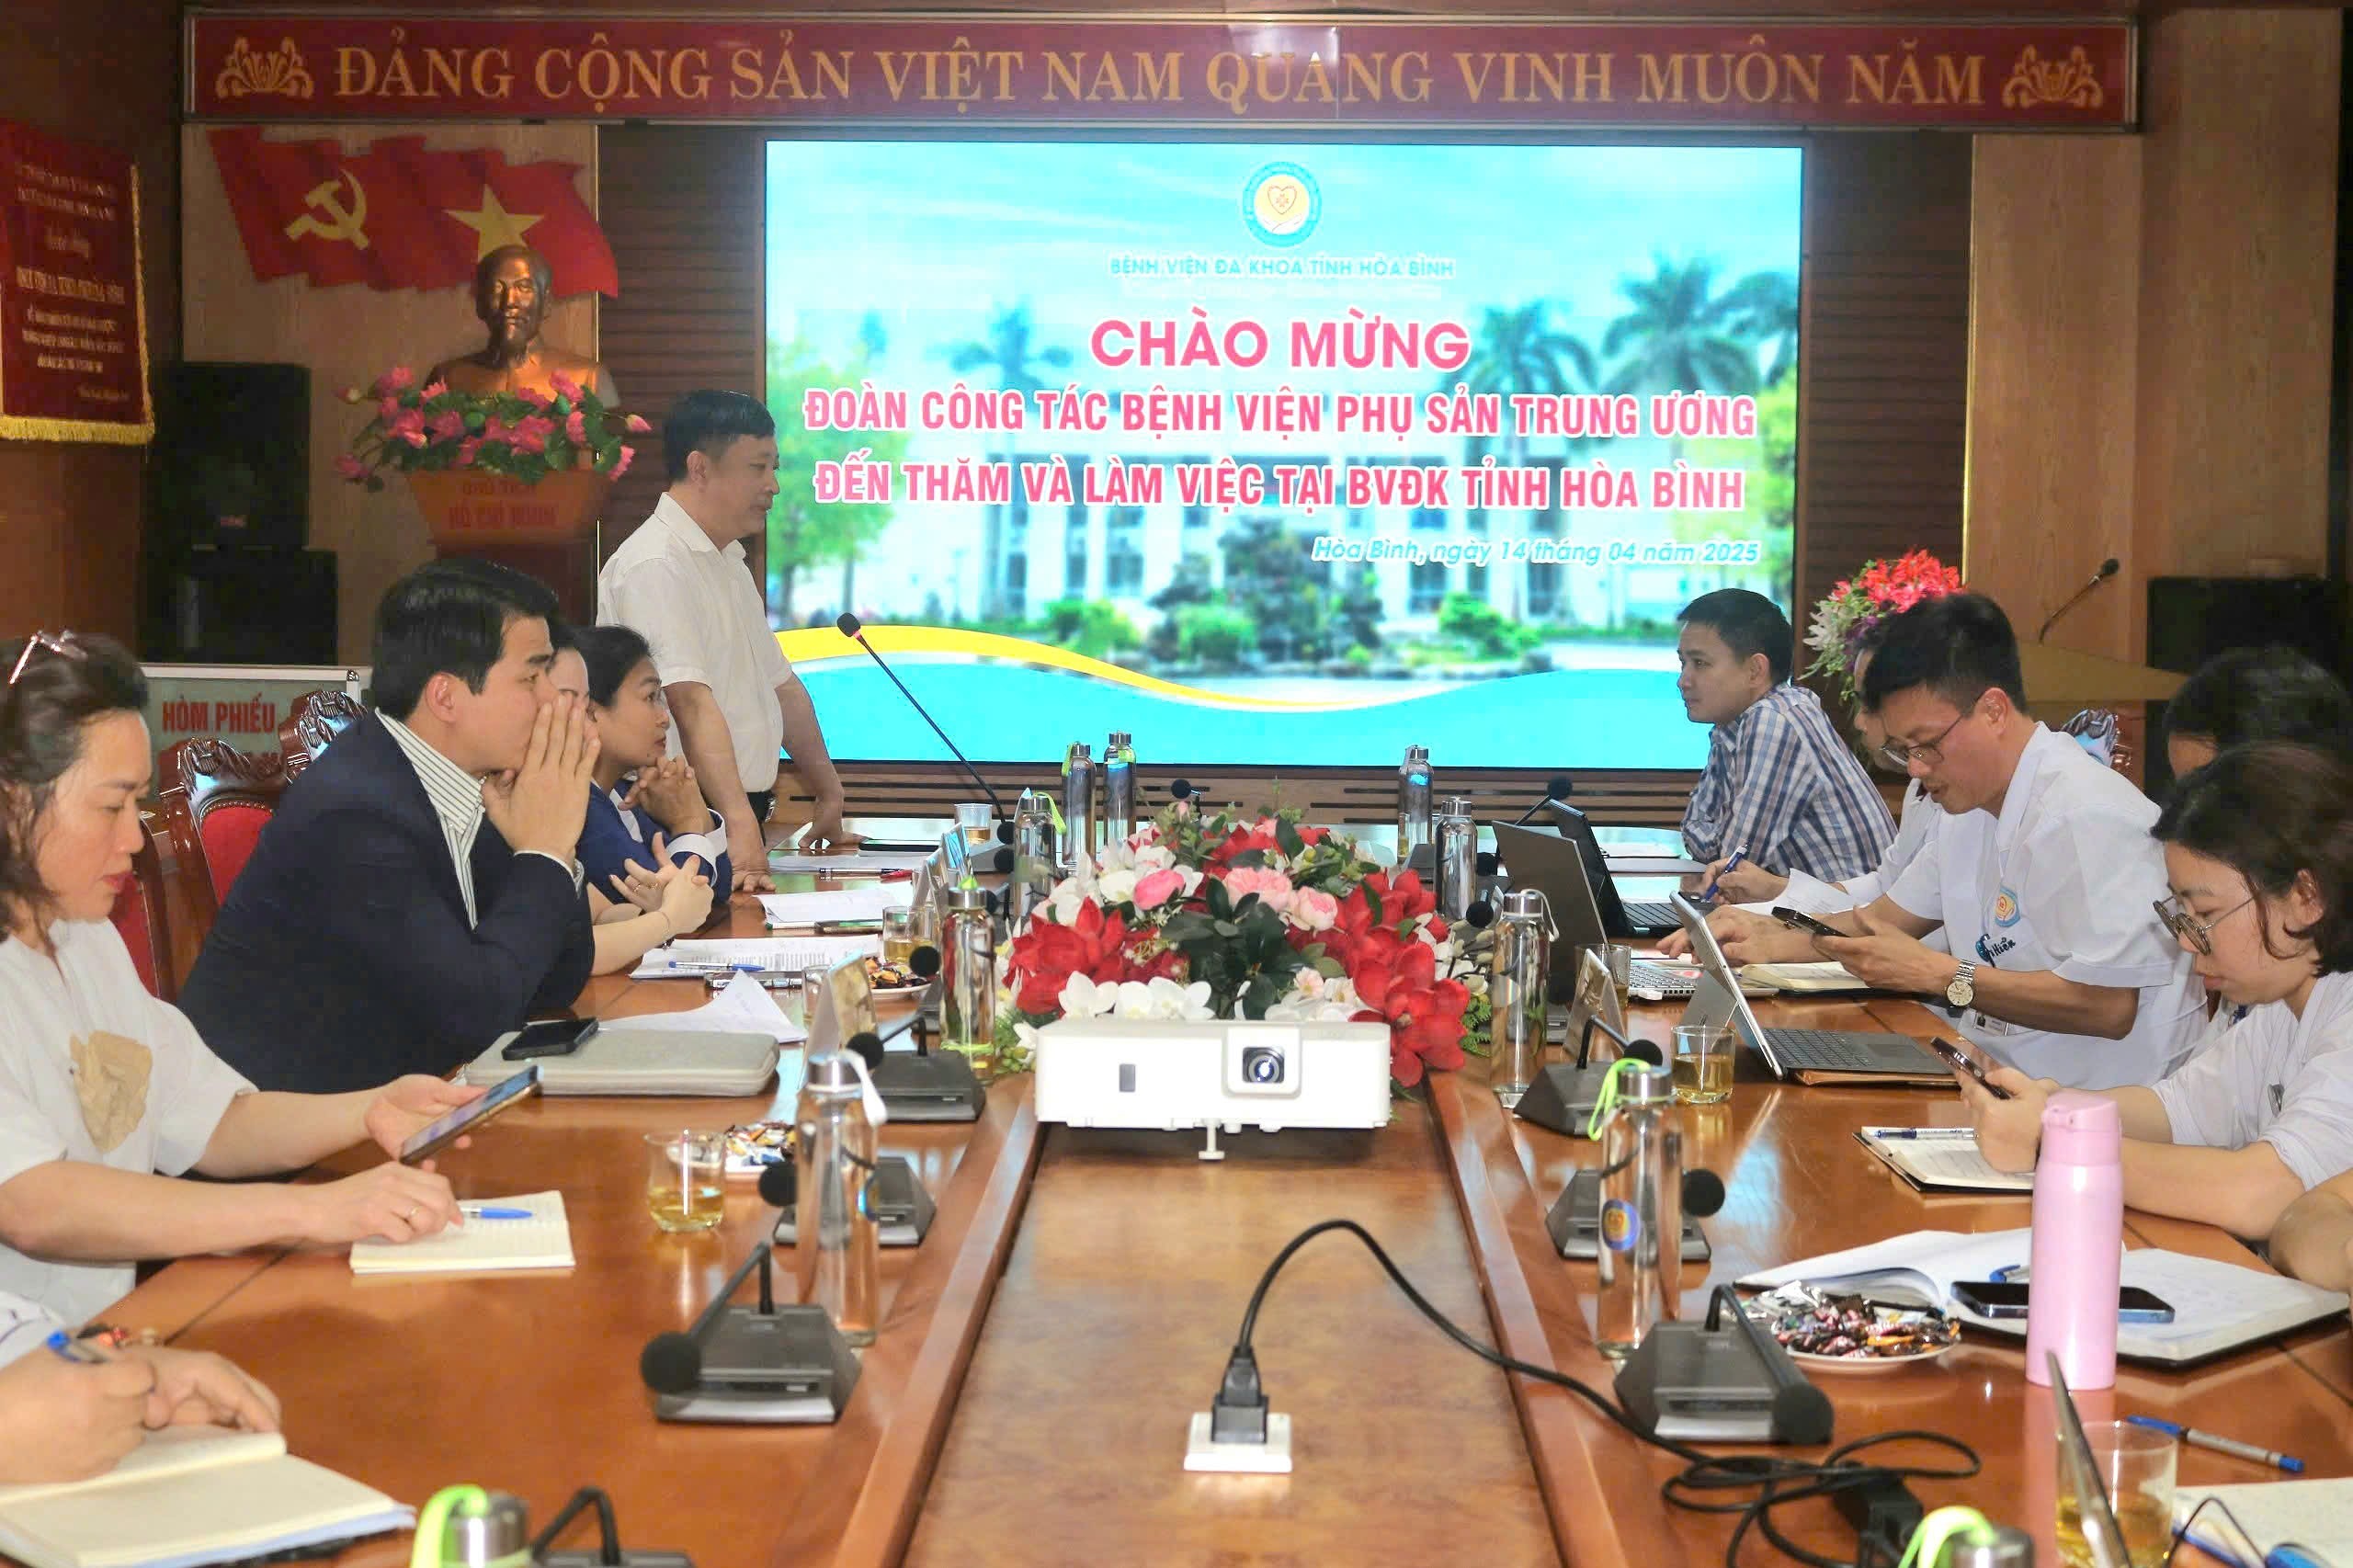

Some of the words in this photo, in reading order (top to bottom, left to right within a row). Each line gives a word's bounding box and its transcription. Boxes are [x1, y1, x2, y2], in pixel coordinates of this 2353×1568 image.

[334, 28, 515, 99] ĐẢNG
[535, 31, 713, 112] CỘNG
[729, 29, 851, 101] SẢN
[873, 36, 1024, 113] VIỆT
[1045, 51, 1183, 102] NAM
[1205, 51, 1434, 115] QUANG
[1454, 52, 1615, 104] VINH
[1635, 34, 1824, 104] MUÔN
[1845, 40, 1985, 105] NĂM
[1110, 254, 1158, 276] BỆNH
[1166, 254, 1208, 277] VIỆN
[1215, 258, 1240, 275] ĐA
[1249, 258, 1302, 276] KHOA
[1409, 254, 1454, 277] BÌNH
[1091, 306, 1268, 367] CHÀO
[1291, 308, 1470, 369] MỪNG
[805, 382, 906, 428] ĐOÀN
[922, 382, 1023, 429] CÔNG
[1036, 384, 1107, 430] TÁC
[1123, 385, 1221, 439] BỆNH
[1236, 386, 1320, 440] VIỆN
[1337, 395, 1412, 441] PHỤ
[1427, 384, 1498, 434] SẢN
[1513, 397, 1636, 435] TRUNG
[1654, 392, 1754, 436] ƯƠNG
[815, 449, 889, 502] ĐẾN
[904, 457, 1009, 502] THĂM
[1023, 456, 1071, 502] VÀ
[1086, 457, 1162, 503] LÀM
[1177, 458, 1262, 513] VIỆC
[1276, 468, 1332, 514] TẠI
[1349, 470, 1449, 506] BVĐK
[1461, 457, 1546, 506] TỈNH
[1563, 460, 1638, 507] HÒA
[1654, 461, 1742, 507] BÌNH
[1314, 539, 1362, 561] Hòa
[1369, 539, 1424, 565] Bình,
[1431, 541, 1490, 567] ngày
[1501, 540, 1526, 561] 14
[1532, 540, 1602, 567] tháng
[1610, 542, 1636, 562] 04
[1643, 542, 1694, 562] năm
[1702, 542, 1759, 562] 2025
[162, 694, 209, 733] HÒM
[214, 691, 276, 733] PHIẾU
